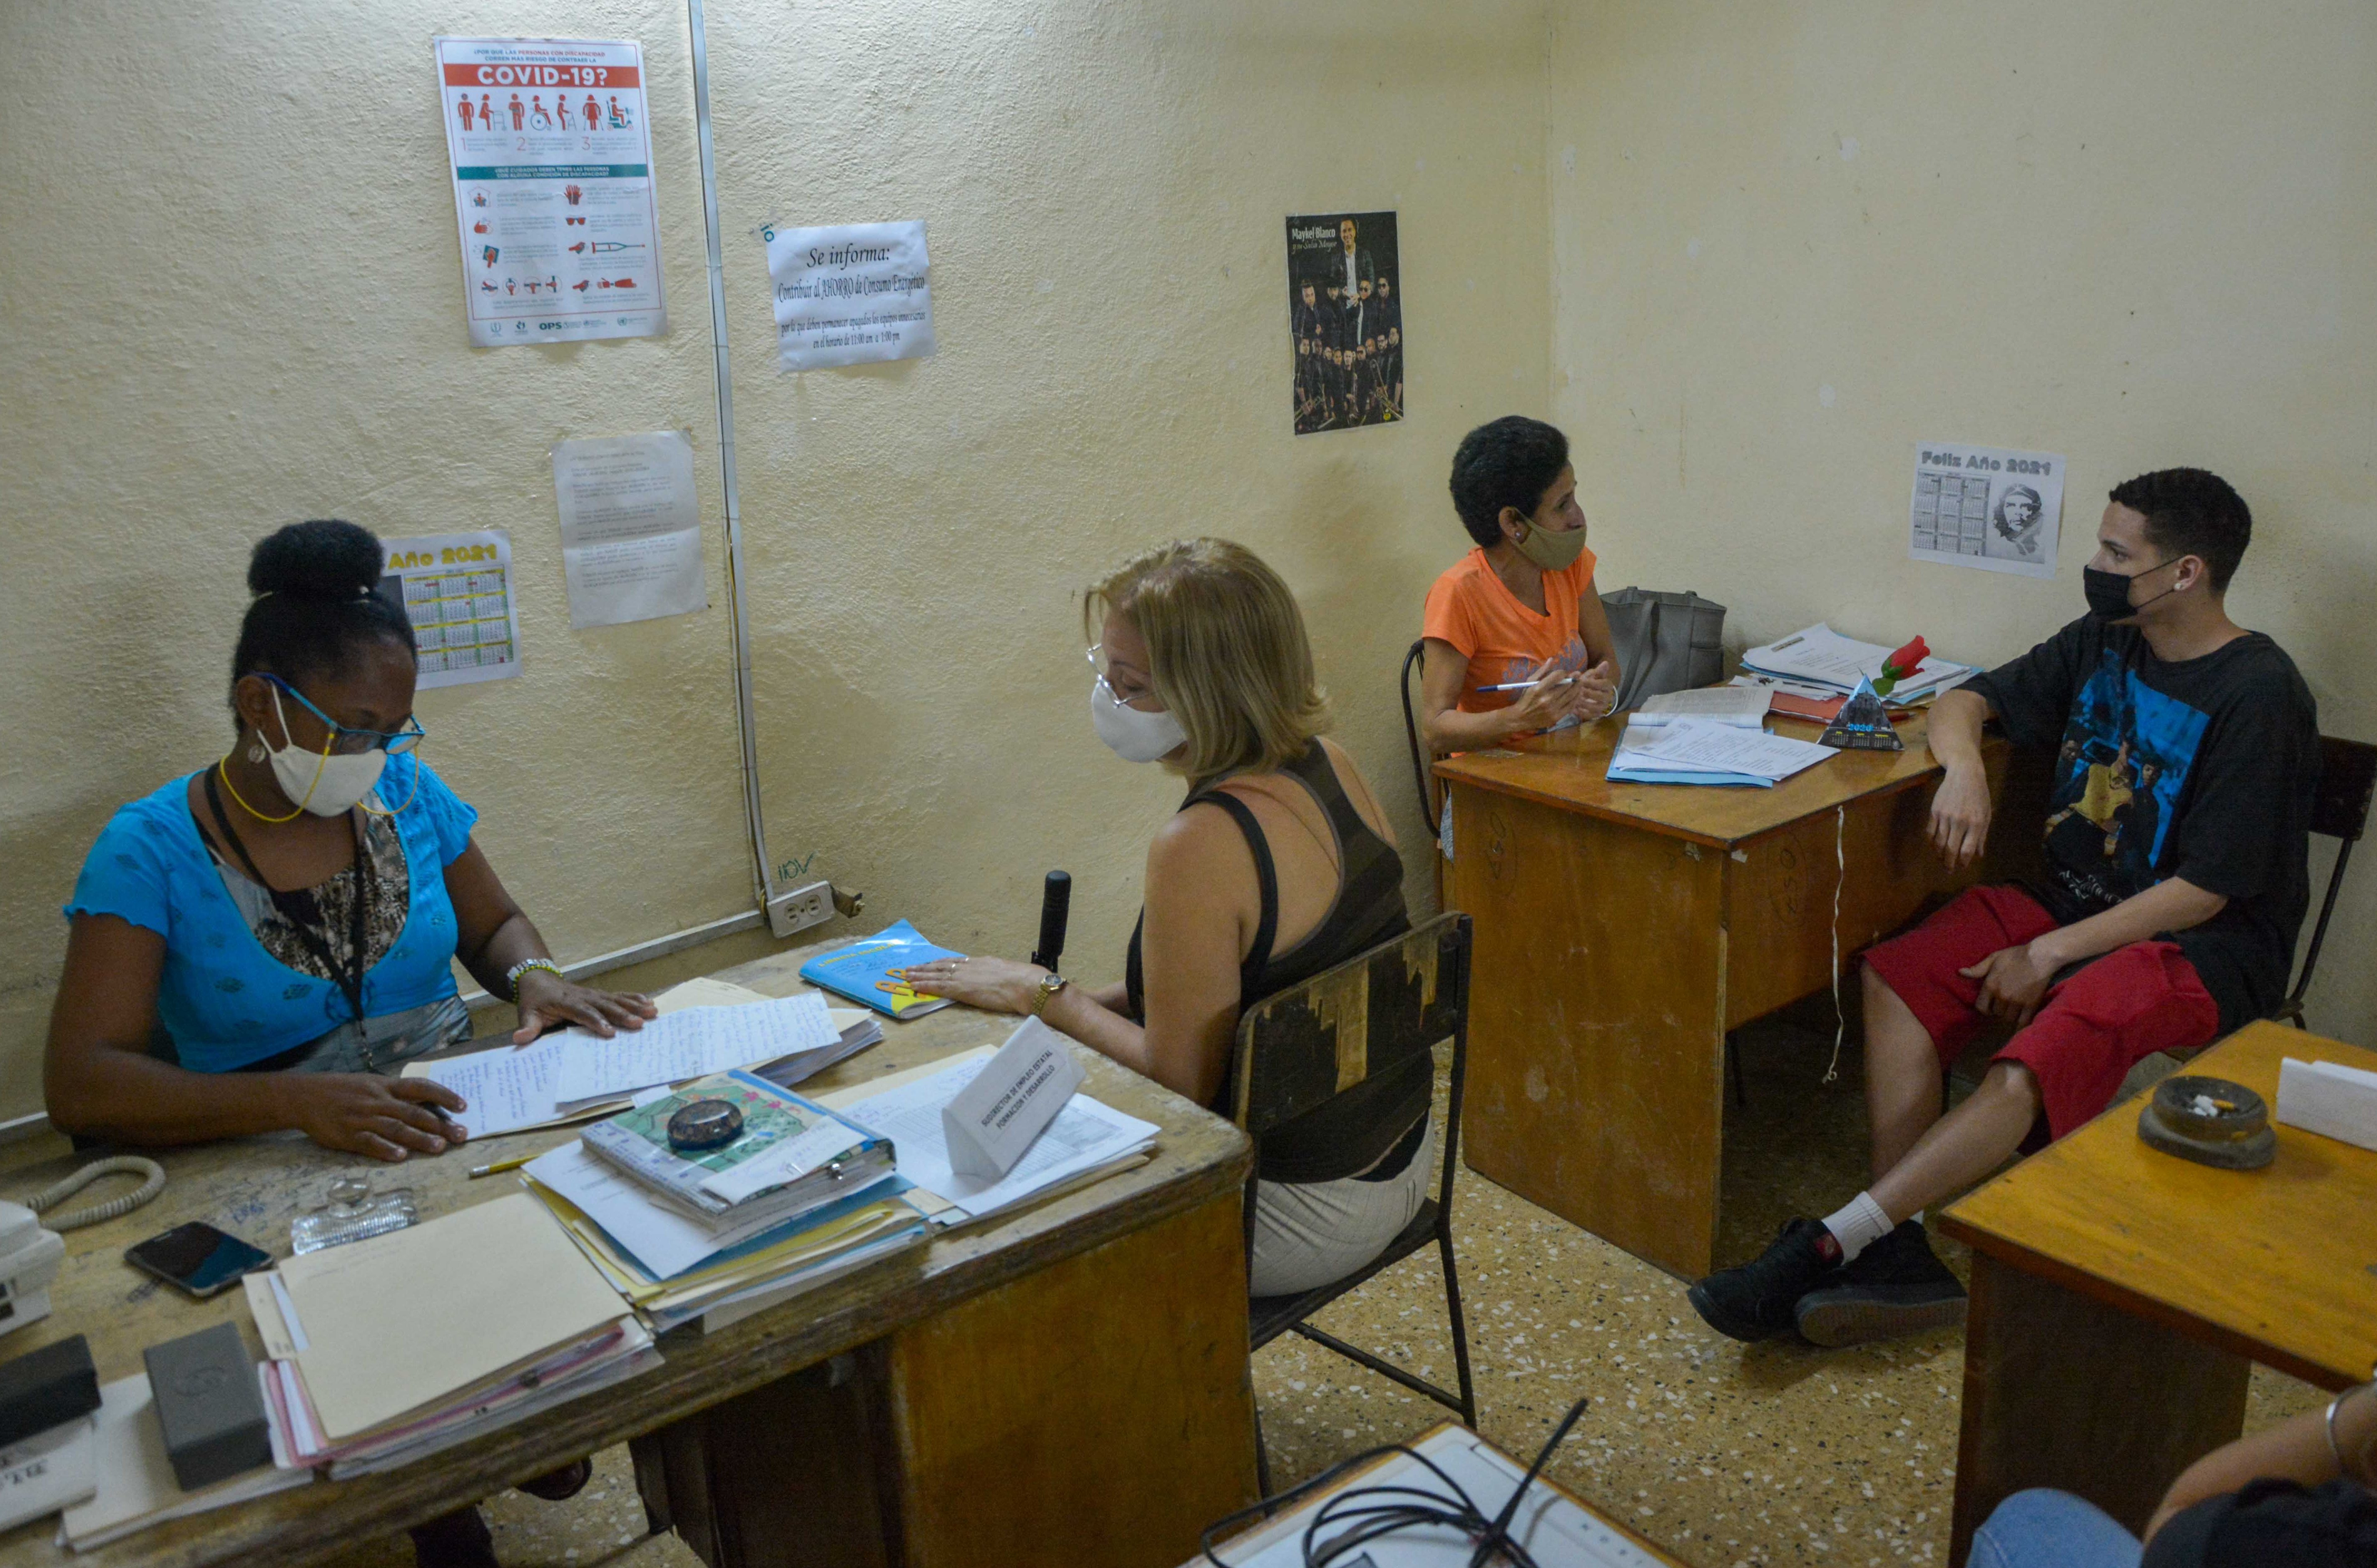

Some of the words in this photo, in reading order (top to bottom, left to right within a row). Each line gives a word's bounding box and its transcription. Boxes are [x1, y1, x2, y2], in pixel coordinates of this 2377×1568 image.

[477, 65, 608, 86] COVID-19?
[461, 137, 467, 151] 1
[516, 137, 527, 152] 2
[581, 136, 591, 151] 3
[1292, 226, 1314, 241] Maykel
[1316, 226, 1335, 239] Blanco
[807, 248, 824, 268] Se
[829, 243, 890, 270] informa:
[779, 279, 812, 303] Contribuir
[814, 277, 820, 297] al
[821, 277, 854, 300] AHORRO
[855, 274, 862, 294] de
[864, 276, 891, 296] Consumo
[539, 321, 562, 330] OPS
[781, 324, 790, 337] por
[797, 323, 806, 336] que
[806, 317, 821, 330] deben
[821, 319, 848, 333] permanecer
[880, 312, 897, 328] equipos
[814, 340, 819, 348] en
[820, 335, 824, 348] el
[826, 335, 843, 348] horario
[844, 333, 849, 346] de
[1922, 451, 1962, 468] Feliz
[1966, 455, 2001, 471] Año
[2006, 459, 2051, 476] 2021
[389, 551, 434, 569] Año
[441, 544, 497, 564] 2021
[1848, 723, 1874, 732] 2020
[778, 851, 818, 882] 110V
[1009, 1086, 1018, 1096] DE
[1016, 1068, 1035, 1090] EMPLEO
[1033, 1050, 1052, 1071] ESTATAL
[1025, 1065, 1055, 1097] DESARROLLO
